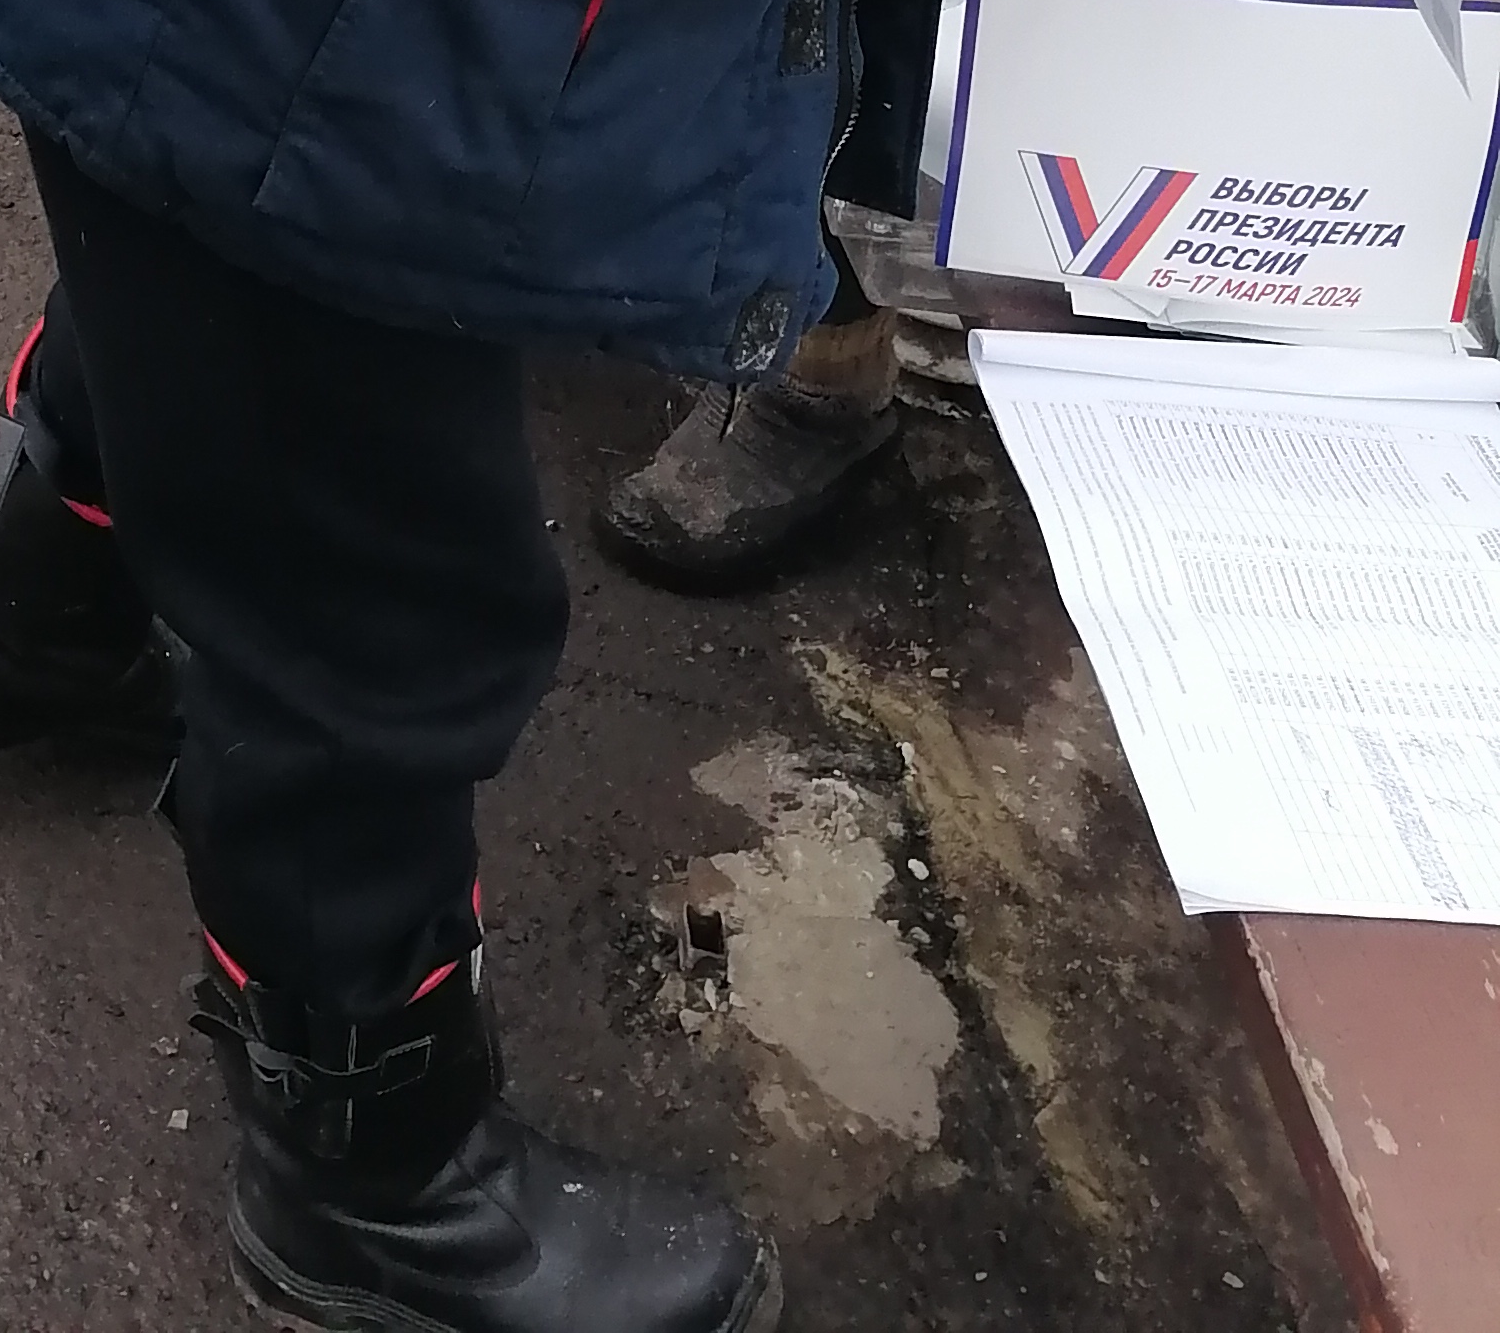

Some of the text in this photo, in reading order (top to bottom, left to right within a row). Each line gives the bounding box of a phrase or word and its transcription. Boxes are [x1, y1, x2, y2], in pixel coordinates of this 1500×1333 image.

[1209, 177, 1369, 213] ВЫБОРЫ
[1186, 208, 1407, 249] ПРЕЗИДЕНТА
[1163, 239, 1309, 277] РОССИИ
[1216, 278, 1303, 305] МАРТА
[1302, 286, 1363, 309] 2024
